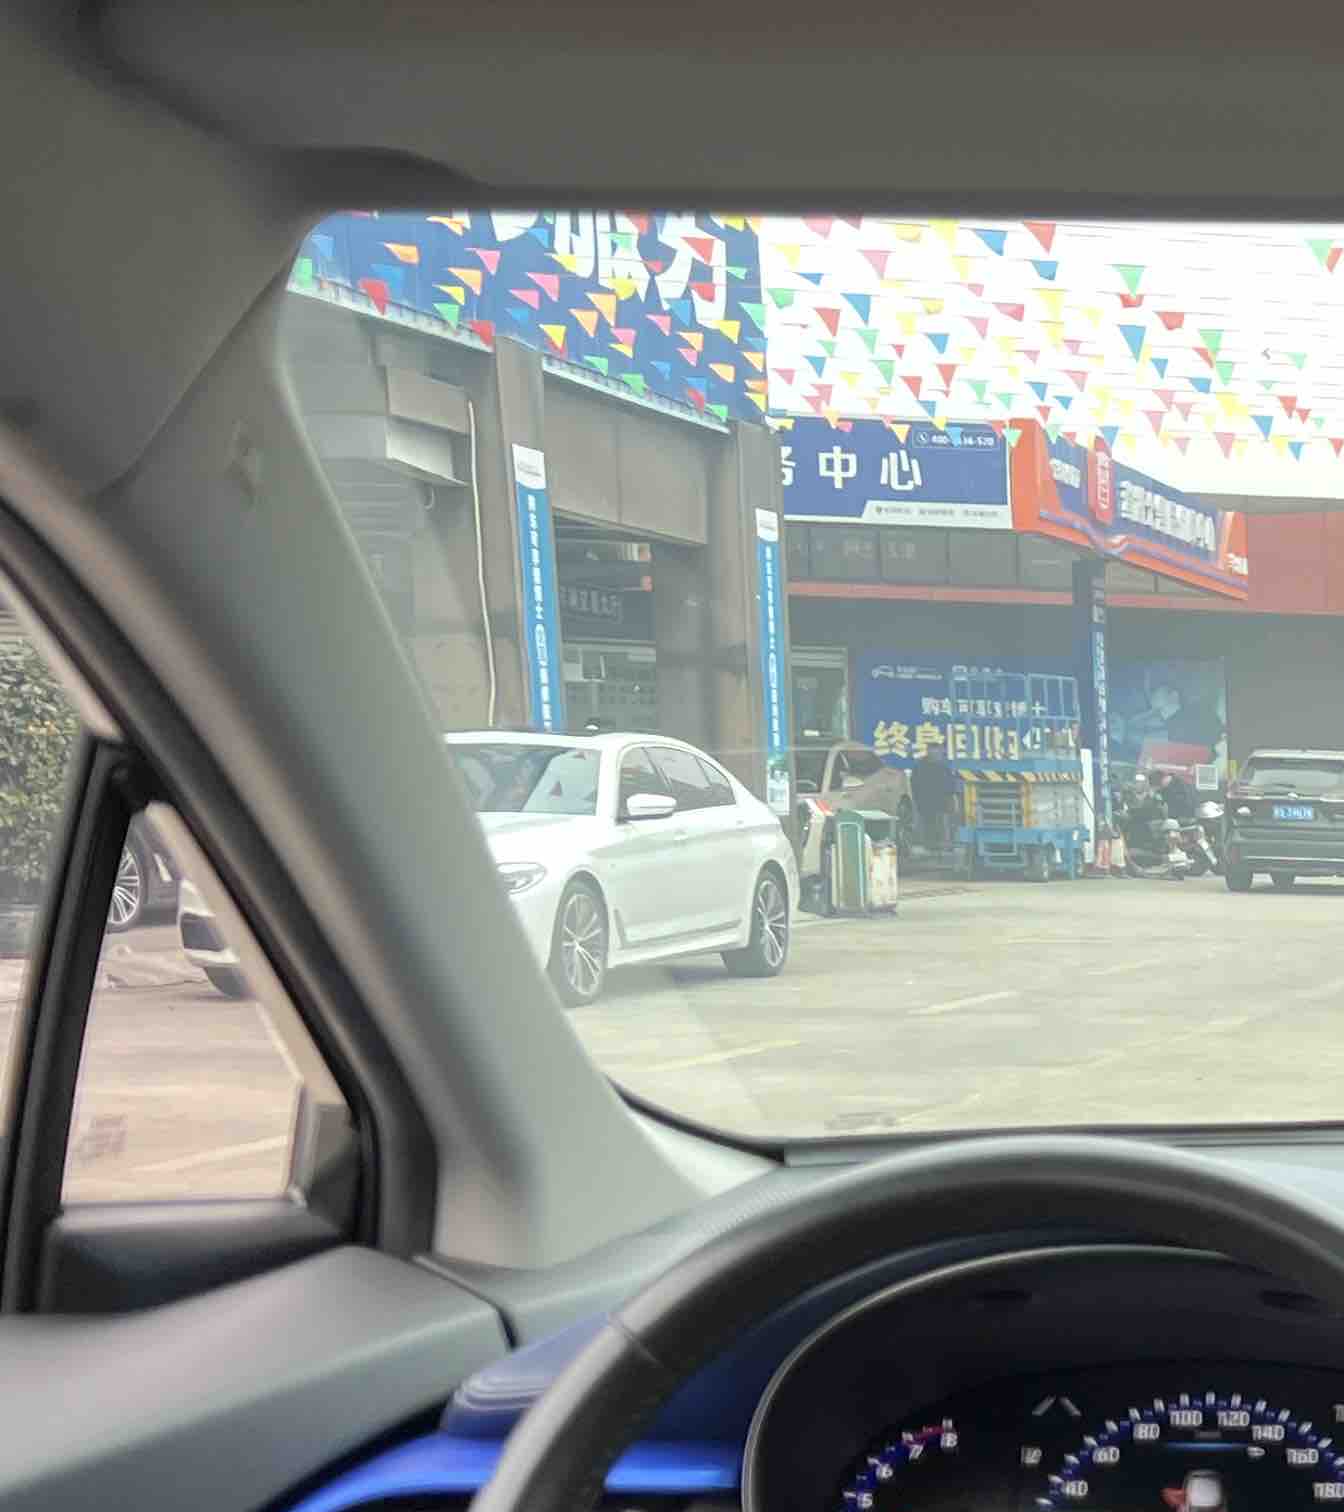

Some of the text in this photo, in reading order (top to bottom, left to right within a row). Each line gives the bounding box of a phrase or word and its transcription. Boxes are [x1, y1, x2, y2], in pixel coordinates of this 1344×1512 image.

[1170, 1410, 1203, 1427] 100
[1217, 1409, 1250, 1427] 120
[1133, 1423, 1160, 1440] 80
[1252, 1423, 1285, 1441] 140
[1287, 1447, 1319, 1465] 160
